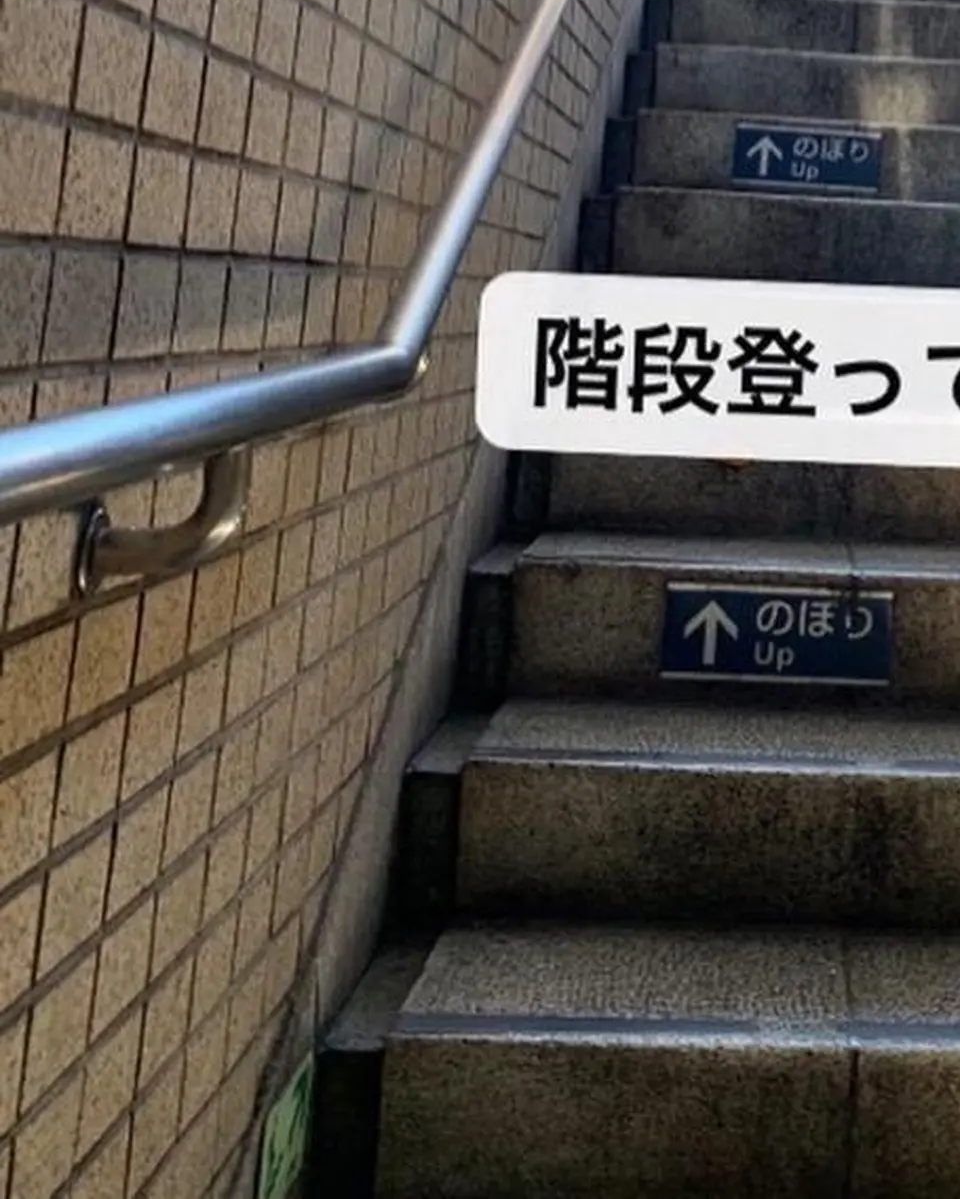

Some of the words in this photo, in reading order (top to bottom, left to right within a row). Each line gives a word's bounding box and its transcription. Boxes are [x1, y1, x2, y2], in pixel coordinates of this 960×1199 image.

[793, 135, 869, 163] のぼり
[790, 161, 819, 181] Up
[756, 600, 874, 639] のぼり
[754, 641, 794, 673] Up
